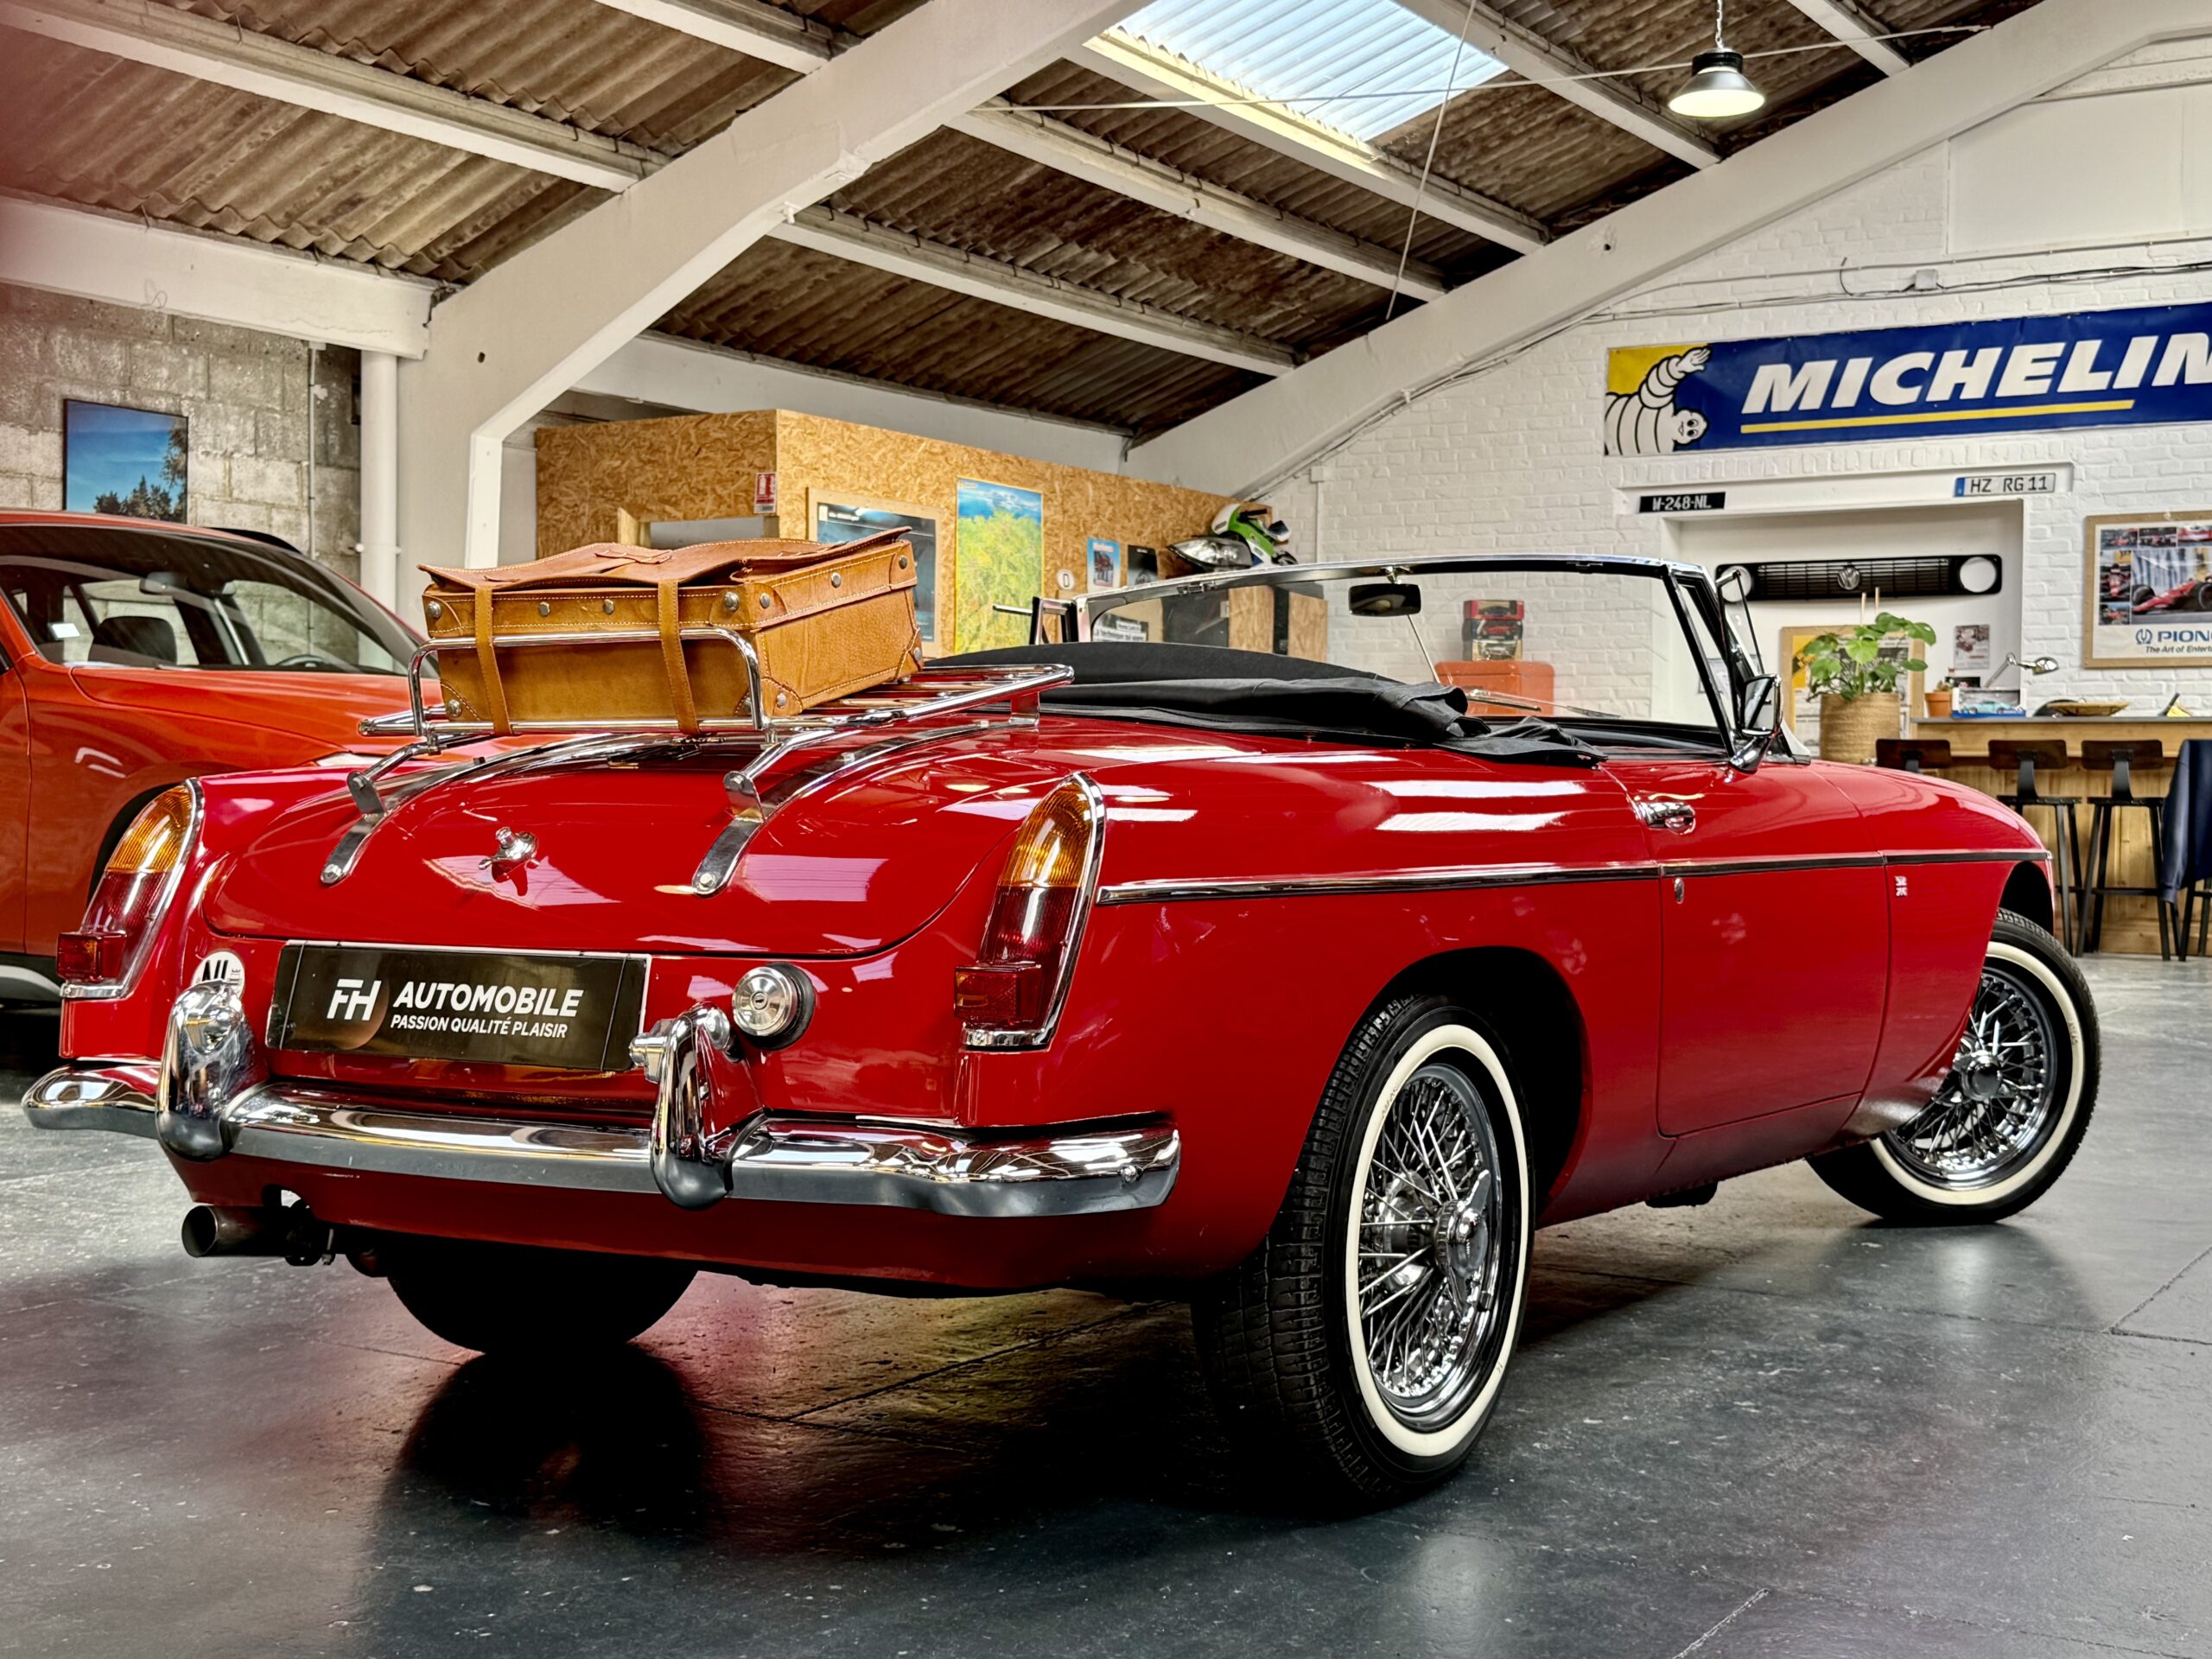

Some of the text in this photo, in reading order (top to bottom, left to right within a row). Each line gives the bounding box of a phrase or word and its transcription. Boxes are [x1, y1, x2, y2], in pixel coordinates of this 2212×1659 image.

[1741, 332, 2212, 414] MICHELIN
[1971, 478, 1992, 493] HZ
[2158, 630, 2212, 642] PION
[327, 978, 584, 1021] FH AUTOMOBILE
[390, 1014, 568, 1039] PASSION QUALITÉ PLAISIR
